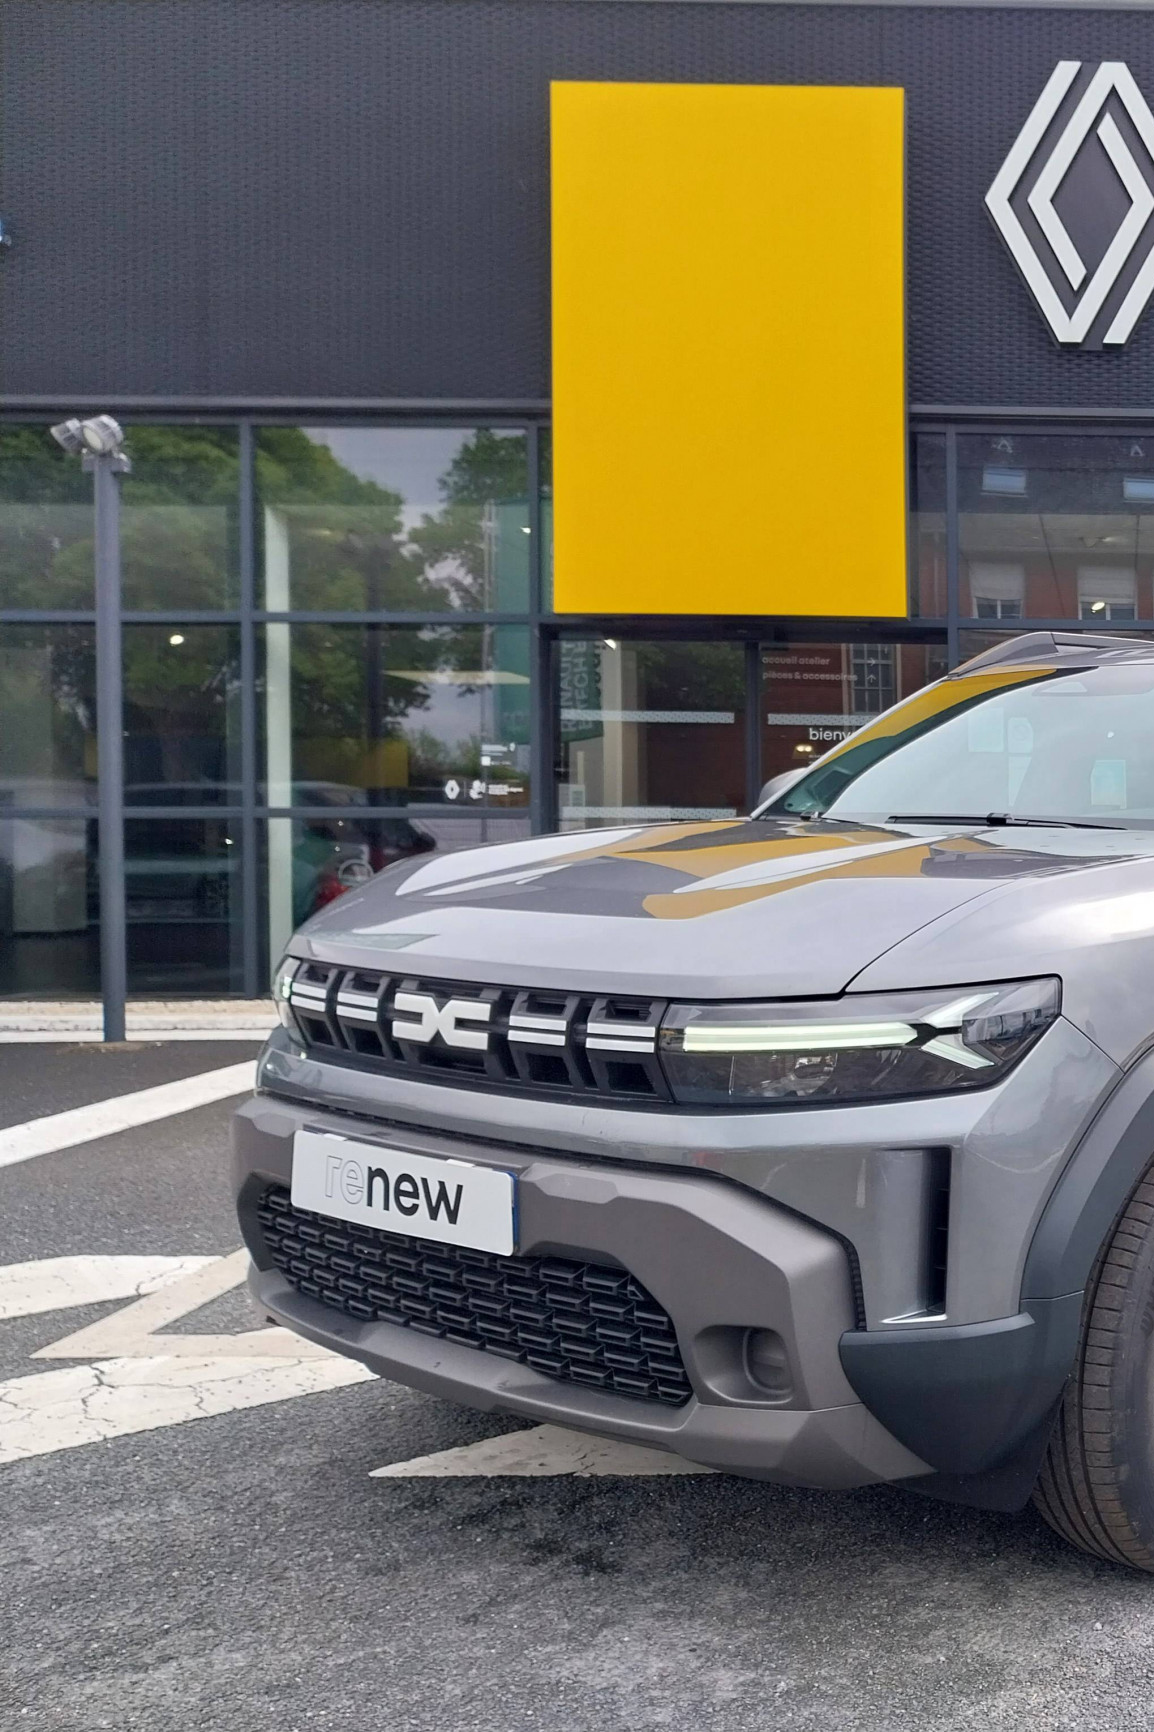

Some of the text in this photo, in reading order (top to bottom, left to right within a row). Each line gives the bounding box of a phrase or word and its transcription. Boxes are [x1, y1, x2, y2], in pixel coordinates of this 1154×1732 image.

[762, 656, 830, 665] accueil atelier
[763, 672, 793, 680] pièces
[802, 673, 858, 681] accessoires
[561, 641, 577, 731] RNAULT
[809, 727, 852, 740] bienv
[325, 1155, 464, 1225] renew
